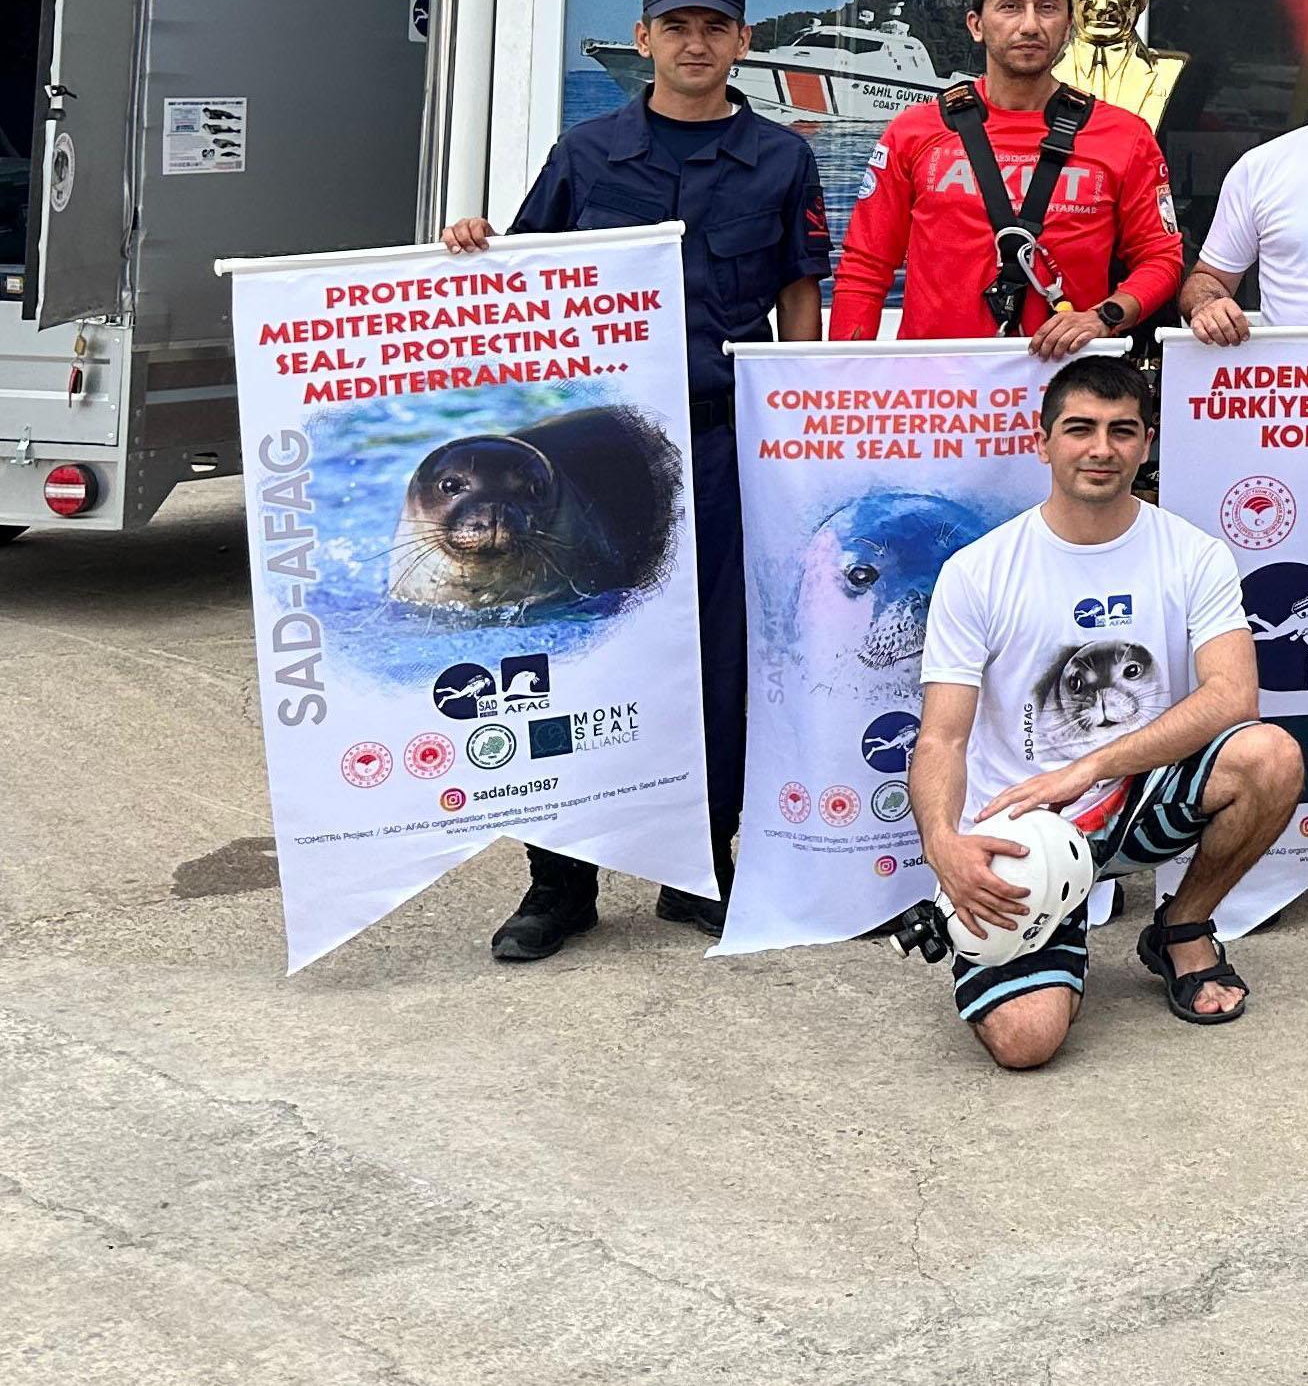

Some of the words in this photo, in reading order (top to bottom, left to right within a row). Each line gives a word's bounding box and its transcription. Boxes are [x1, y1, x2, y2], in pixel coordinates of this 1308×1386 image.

[873, 100, 900, 111] COAST
[326, 271, 527, 309] PROTECTING
[539, 266, 598, 289] THE
[258, 301, 549, 345] MEDITERRANEAN
[564, 290, 662, 318] MONK
[276, 346, 367, 375] SEAL,
[381, 327, 580, 366] PROTECTING
[592, 320, 649, 345] THE
[303, 356, 629, 404] MEDITERRANEAN...
[767, 389, 984, 411] CONSERVATION
[989, 387, 1028, 408] OF
[759, 440, 844, 460] MONK
[856, 440, 922, 459] SEAL
[934, 438, 963, 458] IN
[258, 429, 327, 727] SAD-AFAG
[478, 700, 498, 712] SAD
[504, 699, 551, 714] AFAG
[574, 702, 639, 726] MONK
[574, 718, 639, 740] SEAL
[1023, 702, 1035, 762] SAD-AFAG
[575, 730, 640, 753] ALLIANCE
[473, 777, 559, 801] sadafag1987
